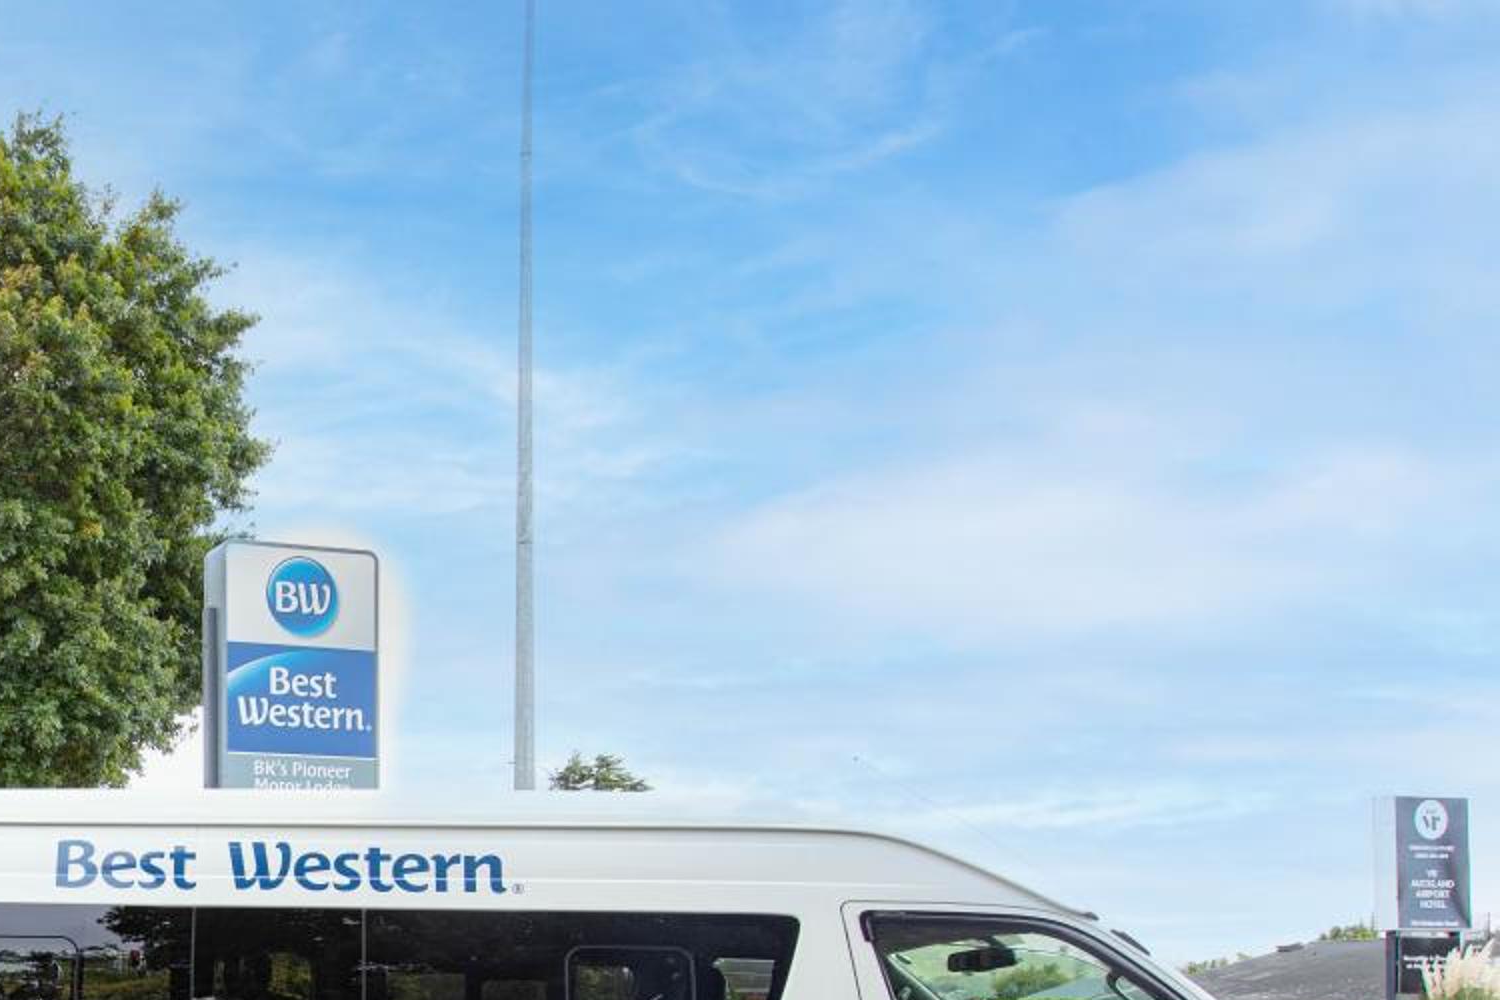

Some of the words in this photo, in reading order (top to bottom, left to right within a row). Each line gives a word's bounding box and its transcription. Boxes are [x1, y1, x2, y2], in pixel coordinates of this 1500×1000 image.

[275, 580, 331, 616] BW
[269, 666, 337, 698] Best
[254, 760, 287, 776] BK's
[293, 761, 352, 778] Pioneer
[56, 839, 197, 890] Best
